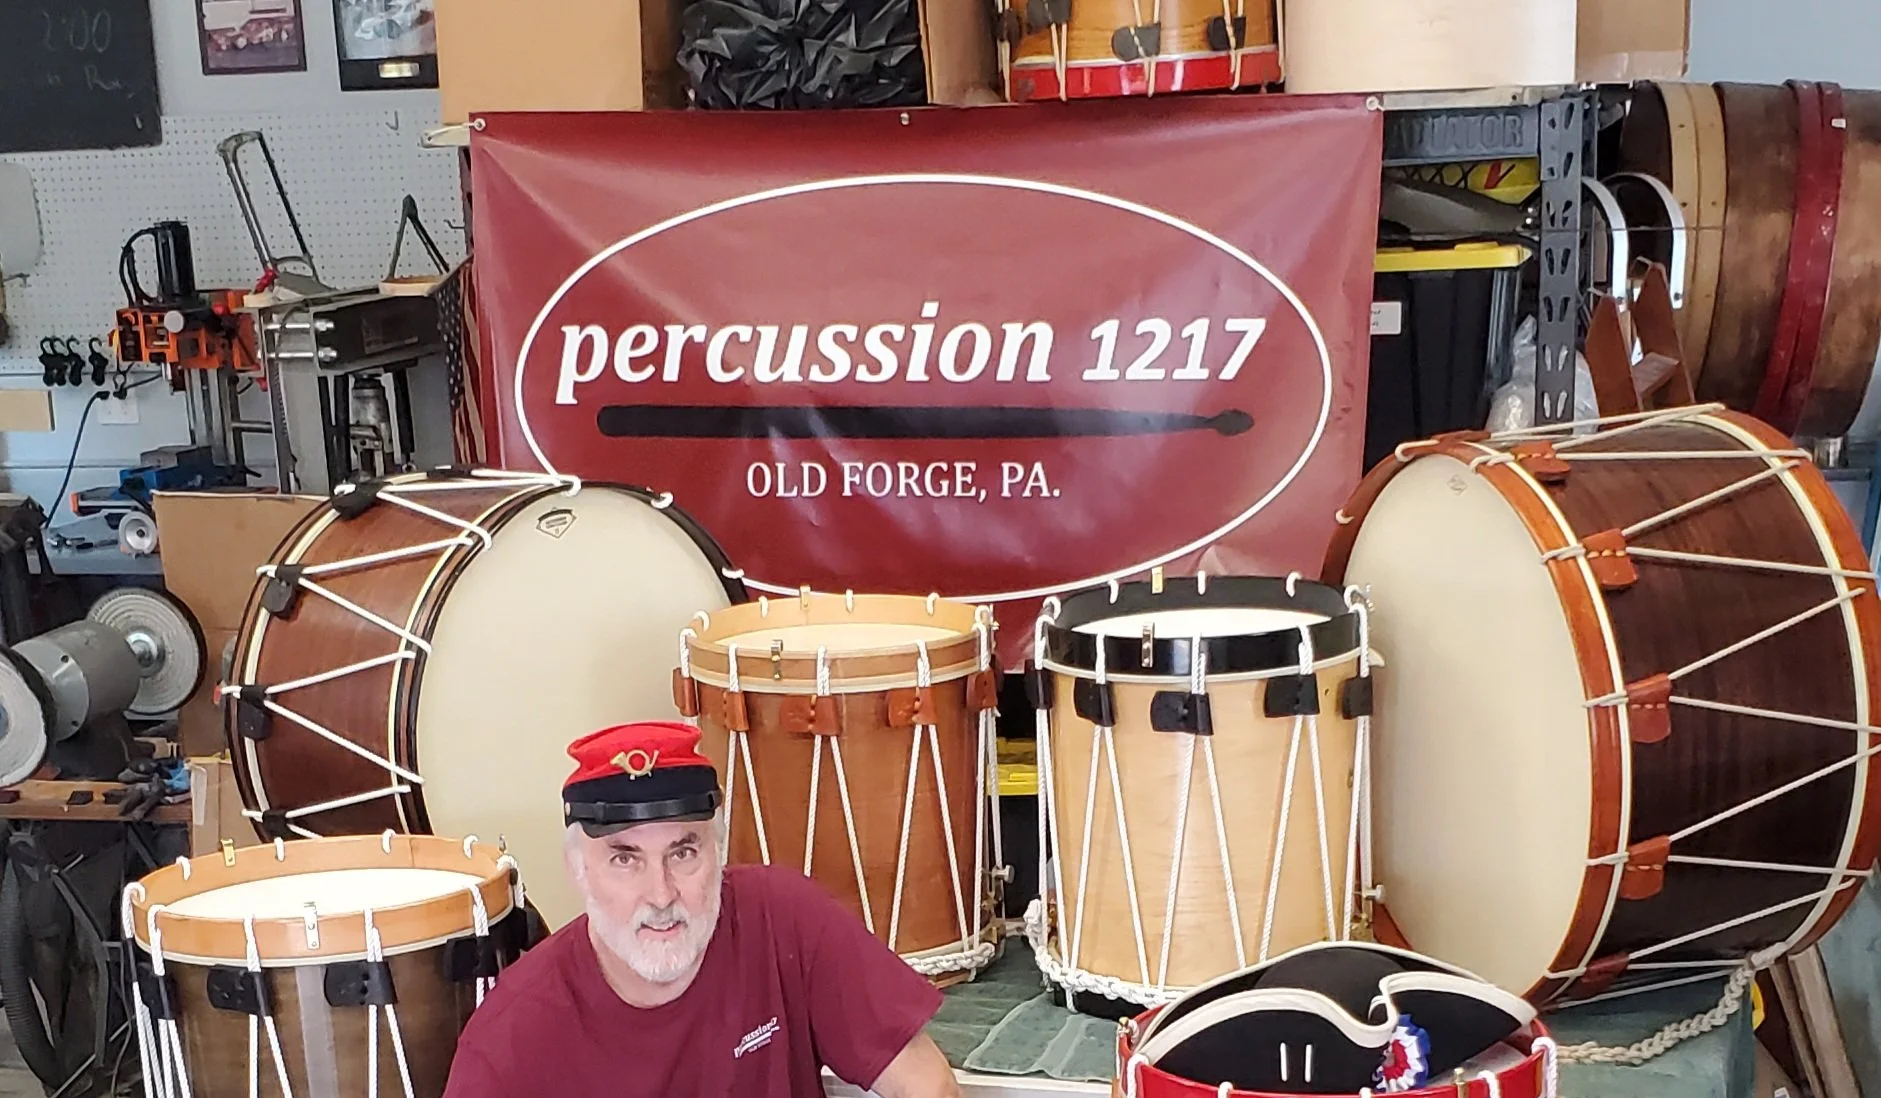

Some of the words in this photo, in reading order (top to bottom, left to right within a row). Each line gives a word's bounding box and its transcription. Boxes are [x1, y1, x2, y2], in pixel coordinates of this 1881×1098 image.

[555, 301, 1055, 404] percussion
[1082, 317, 1267, 381] 1217
[746, 461, 828, 497] OLD
[841, 461, 988, 503] FORGE,
[1001, 461, 1061, 498] PA.
